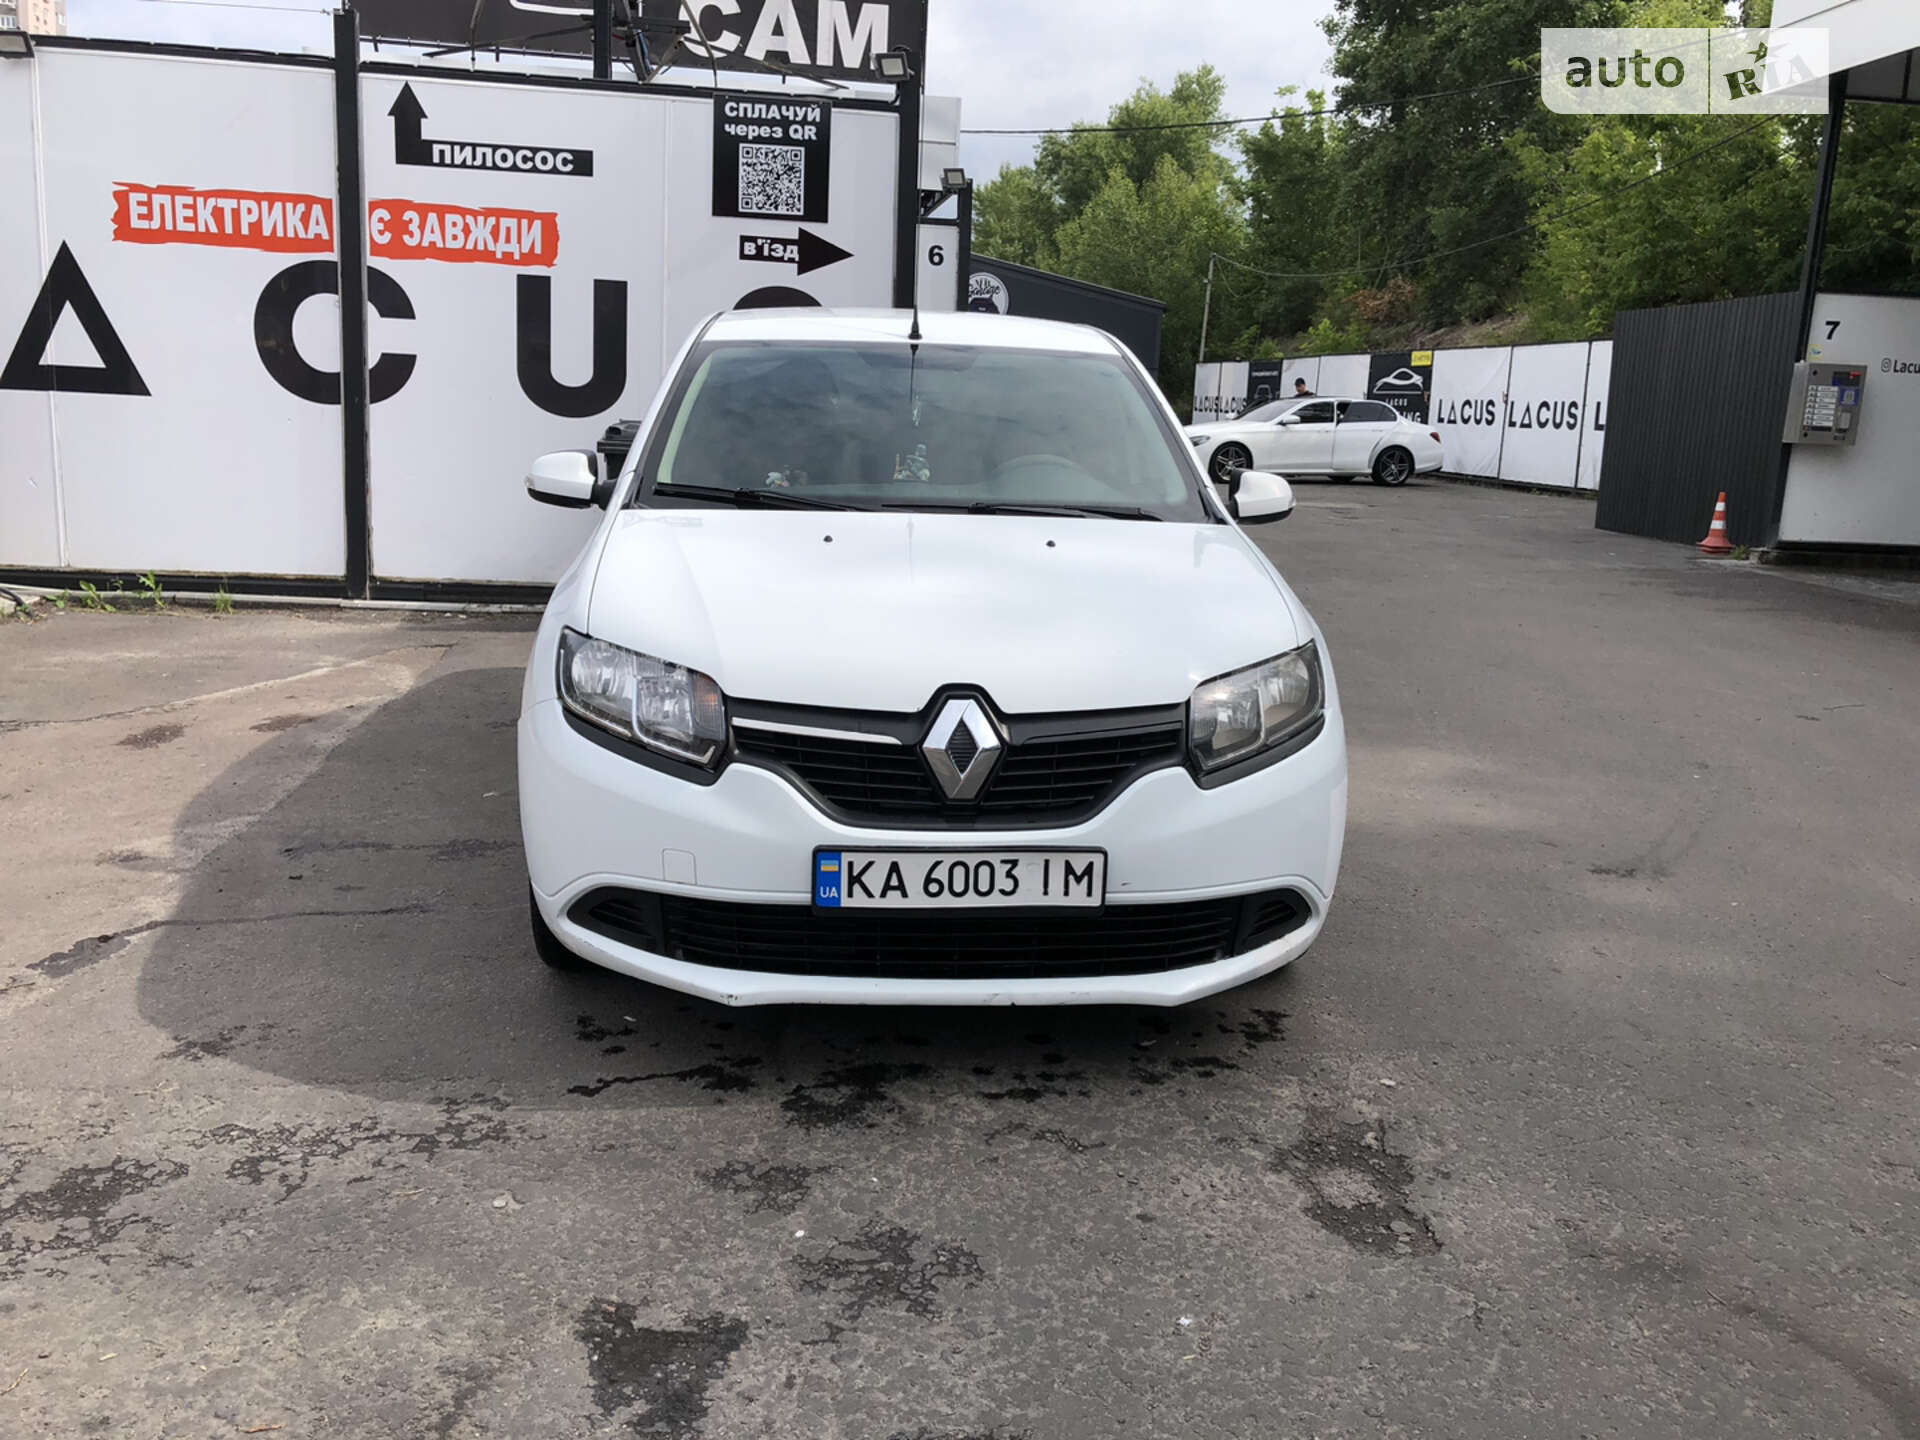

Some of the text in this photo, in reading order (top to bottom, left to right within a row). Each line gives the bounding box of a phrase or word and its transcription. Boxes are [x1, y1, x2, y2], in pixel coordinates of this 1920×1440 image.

[724, 102, 821, 122] СПЛАЧУЙ
[724, 123, 817, 140] через QR
[128, 192, 543, 260] ЕЛЕКТРИКА Є ЗАВЖДИ
[928, 245, 944, 266] 6
[1825, 321, 1841, 340] 7
[1437, 399, 1496, 426] LACUS
[1508, 400, 1579, 430] LACUS
[846, 859, 1094, 899] KA 6003 IM
[820, 886, 839, 898] UA
